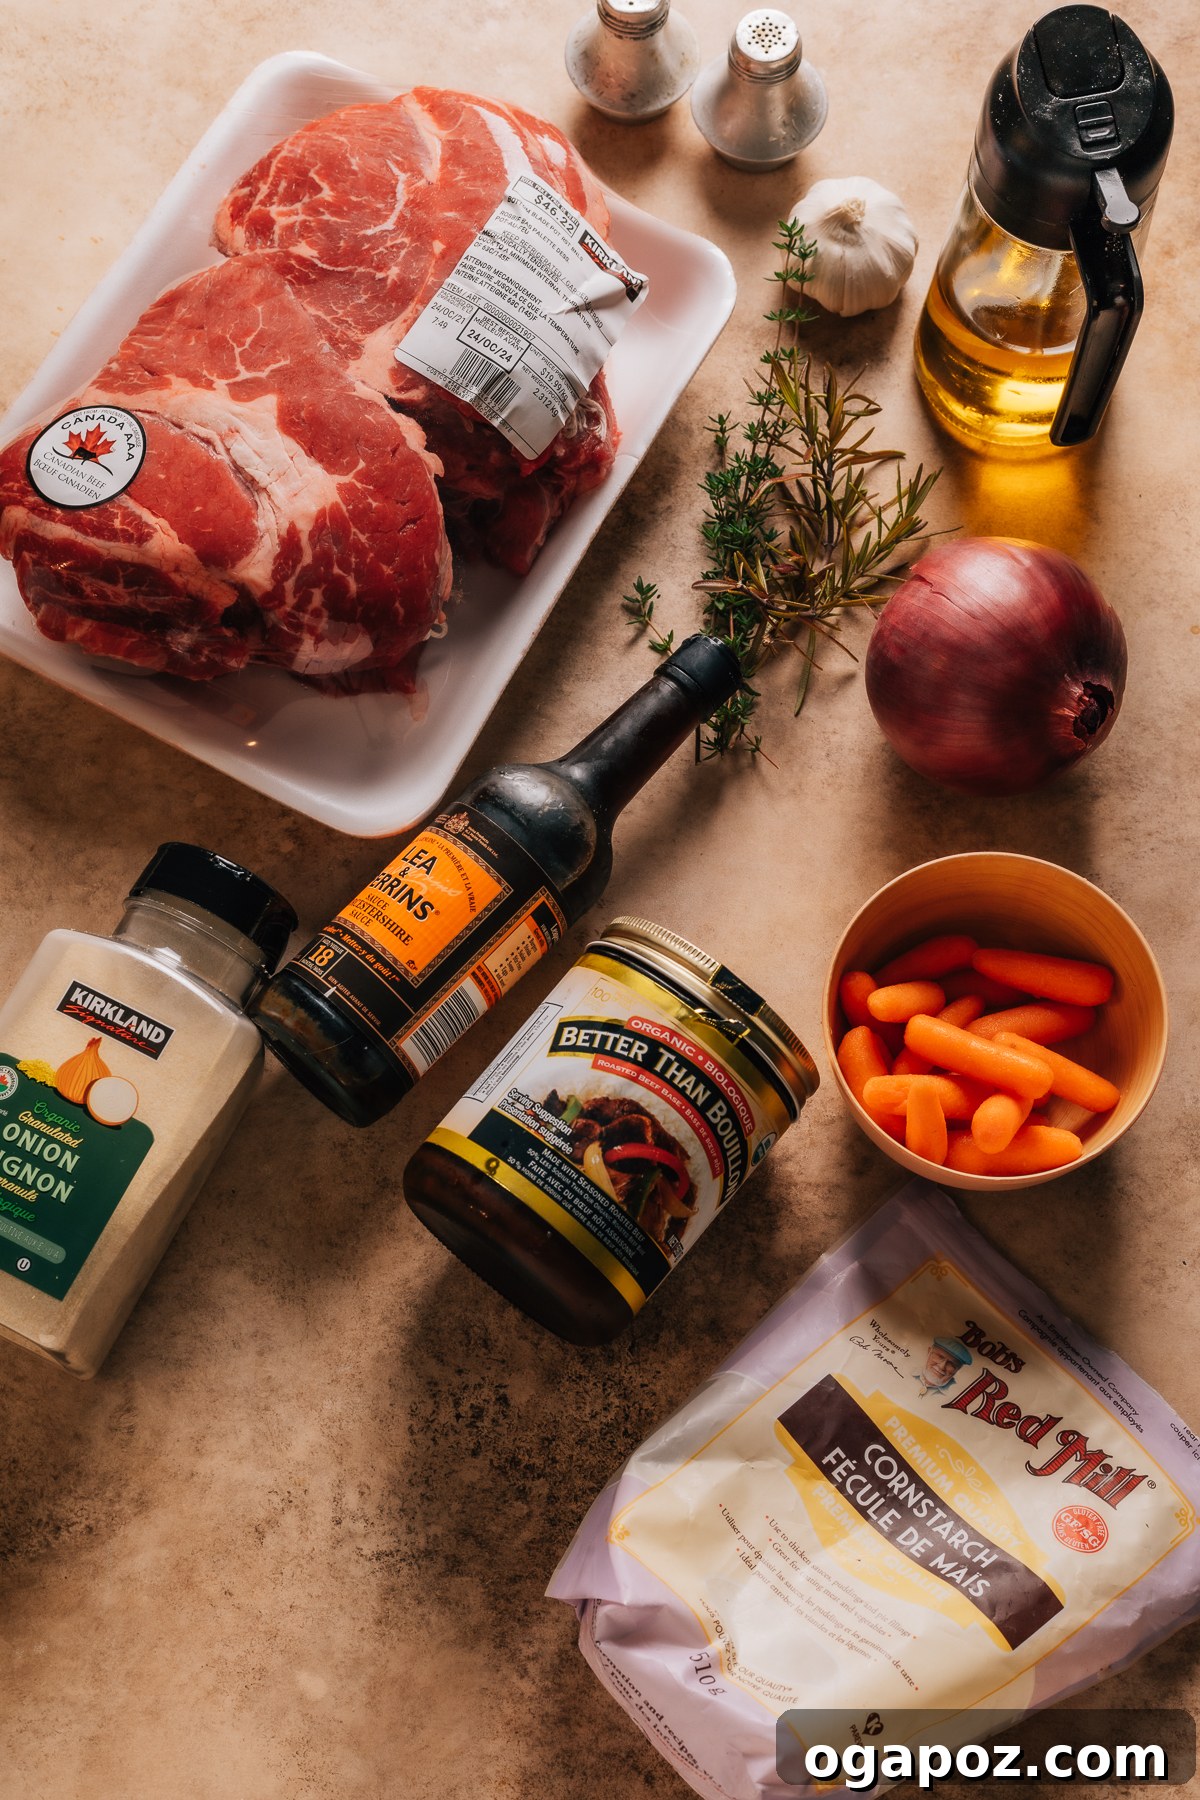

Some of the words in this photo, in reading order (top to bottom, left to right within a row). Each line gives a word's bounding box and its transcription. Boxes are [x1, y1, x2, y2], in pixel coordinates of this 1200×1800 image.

[534, 194, 575, 235] $46.22
[532, 227, 557, 251] PALETTE
[464, 255, 494, 272] ATTENDRI
[509, 251, 537, 274] MINIMUM
[535, 271, 562, 296] INTERNAL
[447, 282, 462, 295] ITEM
[455, 268, 479, 284] INTERNE
[478, 280, 508, 301] ATTEIGNE
[431, 302, 466, 325] 24/OC/21
[431, 317, 449, 330] 7:49
[459, 262, 476, 274] FAIRE
[475, 269, 494, 282] CUIRE
[518, 294, 528, 304] CE
[527, 301, 539, 313] QUE
[538, 311, 547, 321] LA
[547, 317, 580, 356] TEMPERATURE
[466, 329, 513, 363] 24/OC/24
[482, 316, 498, 329] BEST
[497, 327, 522, 345] BEFORE
[532, 388, 552, 410] 2.312
[550, 406, 560, 418] kg
[61, 414, 125, 430] CANADA
[124, 433, 136, 461] AAA
[33, 459, 58, 476] BŒUF
[57, 473, 101, 500] CANADIEN
[43, 451, 87, 480] CANADIAN
[86, 475, 107, 489] BEEF
[398, 866, 410, 878] &
[401, 845, 438, 876] LEA
[461, 872, 469, 881] ET
[366, 893, 390, 911] SAUCE
[369, 872, 435, 921] ERRINS
[465, 882, 472, 891] LA
[467, 892, 476, 913] VRAIE
[349, 909, 374, 927] SAUCE
[308, 944, 335, 967] 18
[366, 953, 376, 963] du
[63, 1004, 157, 1053] Signature
[70, 987, 166, 1044] KIRKLAND
[631, 1019, 696, 1057] ORGANIC
[704, 1060, 753, 1134] BIOLOGIQUE
[508, 1087, 533, 1110] Serving
[532, 1102, 573, 1136] Suggestion
[558, 1026, 649, 1062] BETTER
[653, 1047, 711, 1106] THAN
[706, 1099, 742, 1200] BOUILLON
[597, 1059, 638, 1077] ROASTED
[638, 1073, 661, 1090] BEEF
[661, 1087, 683, 1107] BASE
[685, 1108, 701, 1128] BASE
[699, 1127, 707, 1138] DE
[18, 1110, 83, 1149] Granulated
[33, 1100, 81, 1133] Organic
[498, 1099, 540, 1130] Présentation
[538, 1127, 574, 1155] suggérée
[2, 1123, 80, 1174] ONION
[0, 1177, 39, 1202] ranulé
[521, 1167, 537, 1180] MOINS
[536, 1178, 544, 1186] DE
[528, 1160, 547, 1178] FAITE
[547, 1176, 564, 1191] AVEC
[563, 1189, 574, 1200] DU
[573, 1197, 593, 1215] BŒUF
[542, 1148, 562, 1166] MADE
[561, 1163, 579, 1180] WITH
[577, 1177, 609, 1207] SEASONED
[608, 1204, 634, 1230] ROASTED
[632, 1227, 646, 1242] BEEF
[869, 1318, 911, 1358] Wholesomely
[956, 1320, 1026, 1373] Bob's
[1018, 1309, 1059, 1348] Compagnie
[1057, 1345, 1100, 1387] appartenant
[1099, 1385, 1113, 1401] aux
[1112, 1399, 1144, 1434] employés
[1036, 1313, 1048, 1325] An
[1048, 1323, 1109, 1383] Employee-Owned
[1108, 1382, 1139, 1416] Company
[941, 1367, 1063, 1450] Red
[1025, 1429, 1149, 1510] Mill
[1169, 1422, 1193, 1449] couper
[884, 1415, 954, 1495] PREMIUM
[954, 1491, 1022, 1549] QUALITY
[821, 1446, 902, 1533] FÉCULE
[896, 1526, 934, 1558] DE
[928, 1552, 992, 1598] MAÏS
[864, 1443, 999, 1568] CORNSTARCH
[1073, 1508, 1098, 1521] GLUTEN
[1095, 1521, 1105, 1537] FREE
[1060, 1512, 1101, 1547] GF/SG
[739, 1552, 757, 1571] Idéal
[769, 1518, 782, 1533] Use
[780, 1532, 789, 1542] to
[788, 1540, 812, 1566] thicken
[831, 1580, 864, 1603] puddings
[772, 1542, 791, 1562] Great
[789, 1560, 801, 1572] for
[721, 1507, 741, 1535] Utiliser
[738, 1534, 756, 1551] pour
[892, 1659, 902, 1670] de
[900, 1669, 915, 1687] tarte
[689, 1651, 717, 1685] 510
[738, 1666, 755, 1678] OUR
[610, 1672, 634, 1700] Pour
[643, 1700, 665, 1723] and
